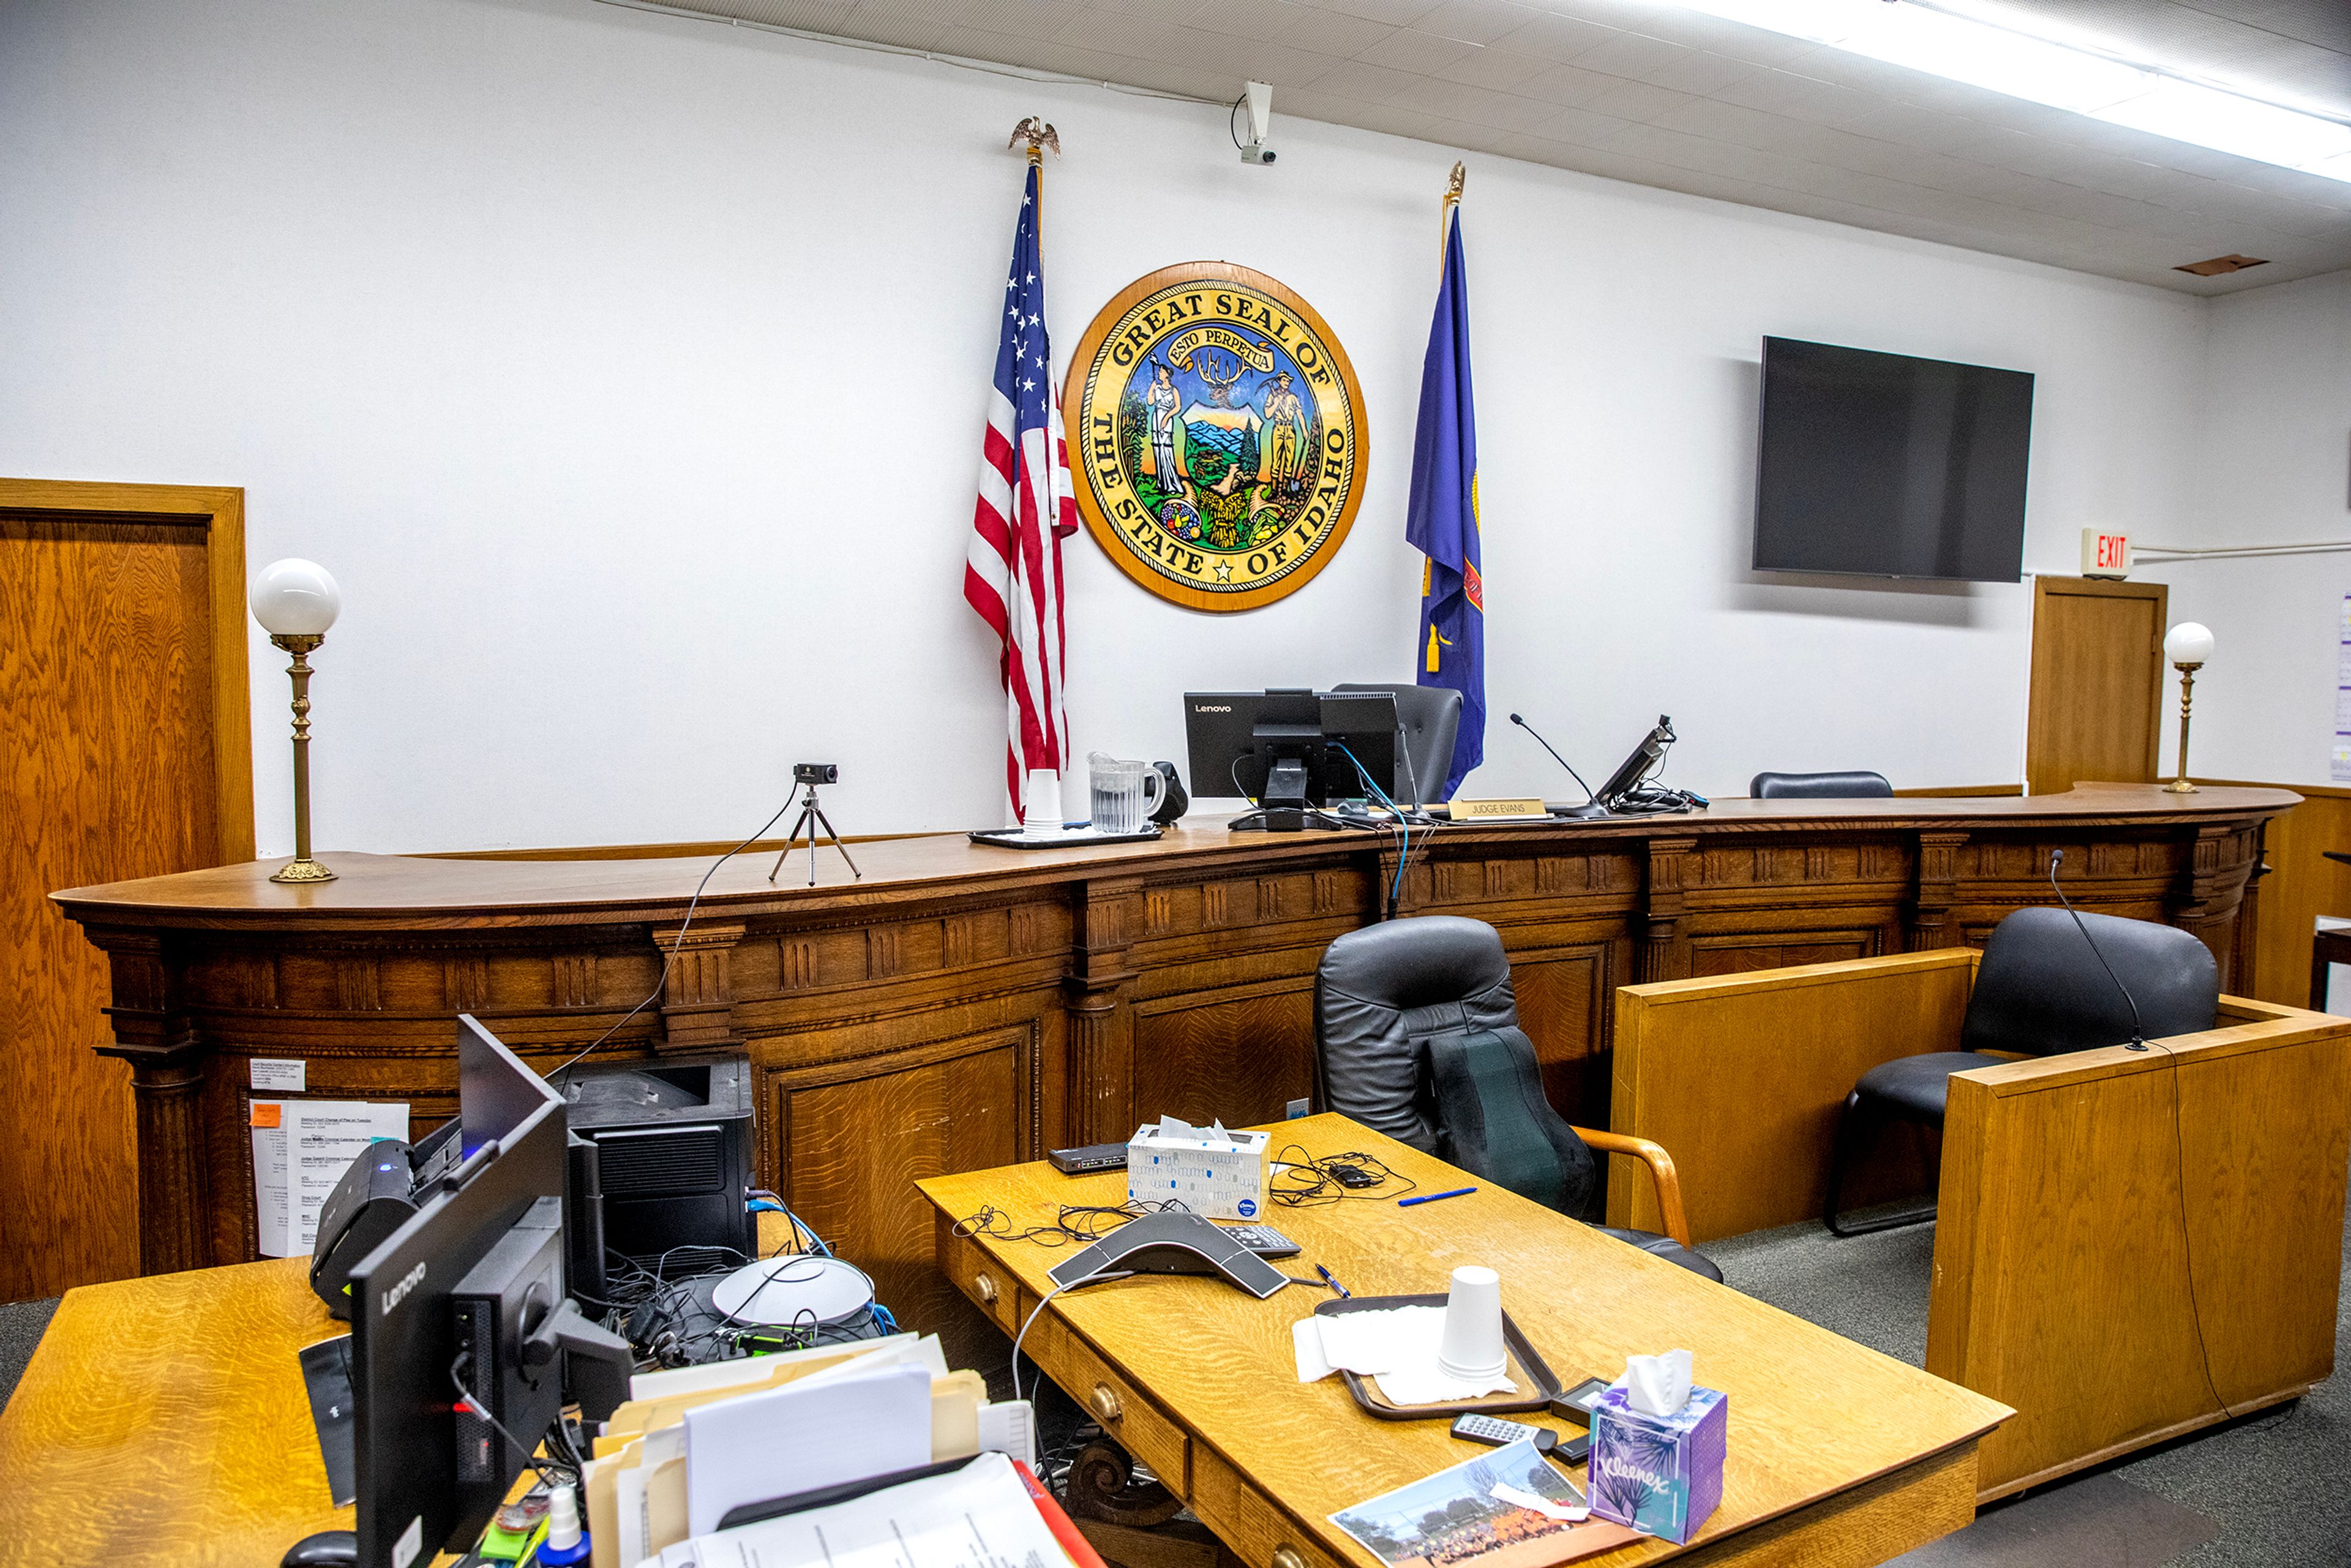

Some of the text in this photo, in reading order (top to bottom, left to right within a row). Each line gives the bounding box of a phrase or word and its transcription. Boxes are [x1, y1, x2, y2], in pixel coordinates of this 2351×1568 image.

[1112, 294, 1330, 386] GREAT SEAL OF
[1170, 329, 1270, 370] ESTO PERPETUA
[1093, 412, 1345, 575] THE STATE OF IDAHO
[2098, 536, 2126, 568] EXIT
[1194, 703, 1232, 713] Lenovo
[1472, 802, 1526, 815] JUDGE EVANS
[381, 1261, 426, 1315] Lenovo
[1600, 1457, 1669, 1494] Kleenex
